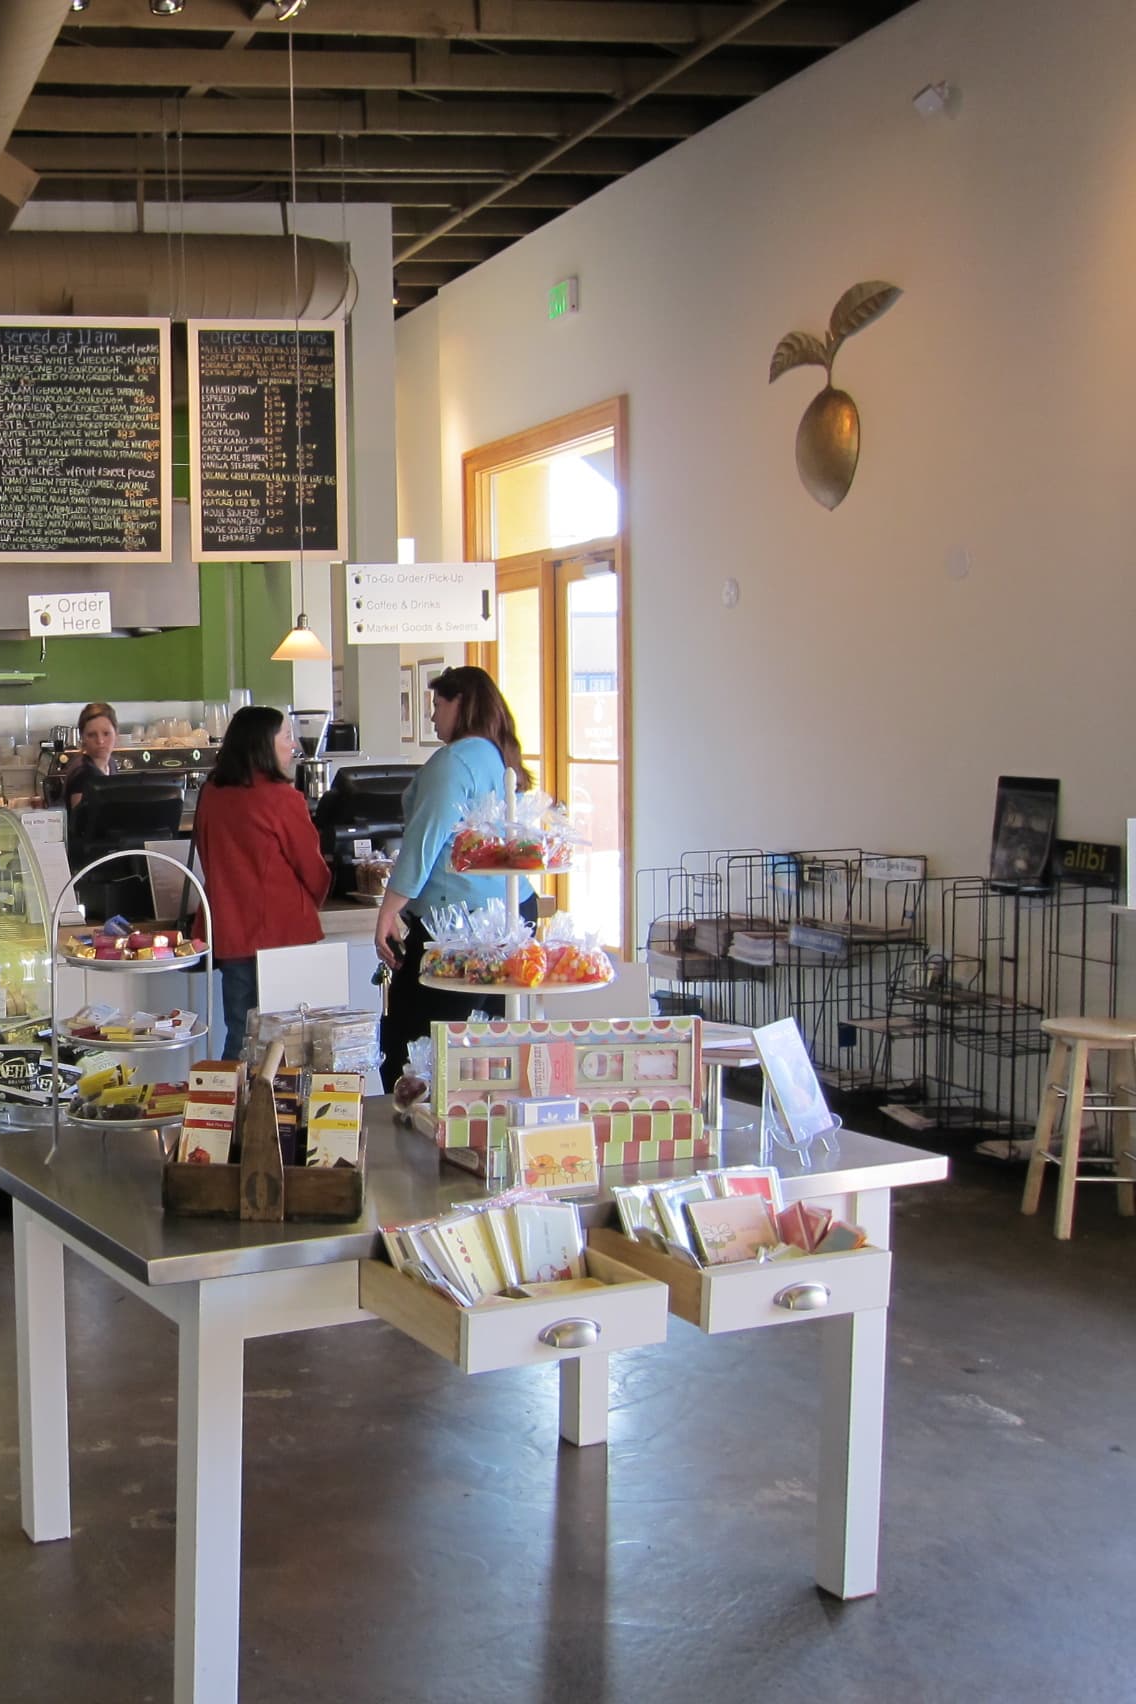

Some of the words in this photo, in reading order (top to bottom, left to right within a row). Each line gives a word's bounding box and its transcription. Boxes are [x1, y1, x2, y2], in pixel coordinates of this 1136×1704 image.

[4, 329, 50, 344] served
[57, 331, 72, 344] at
[8, 344, 68, 357] pressed
[1, 354, 42, 364] CHEESE
[0, 385, 34, 395] SALAMI
[7, 402, 54, 414] MONSIEUR
[202, 404, 226, 412] LATTE
[202, 412, 250, 420] CAPPUCCINO
[202, 420, 228, 428] MOCHA
[202, 428, 240, 436] CORTADO
[366, 574, 394, 584] To-Go
[58, 597, 104, 612] Order
[366, 600, 398, 610] Coffee
[400, 601, 408, 610] &
[411, 600, 440, 610] Drinks
[63, 617, 100, 630] Here
[366, 624, 398, 632] Market
[402, 623, 432, 632] Goods
[437, 623, 442, 632] &
[446, 622, 478, 632] Sweets
[1065, 842, 1108, 871] alibi
